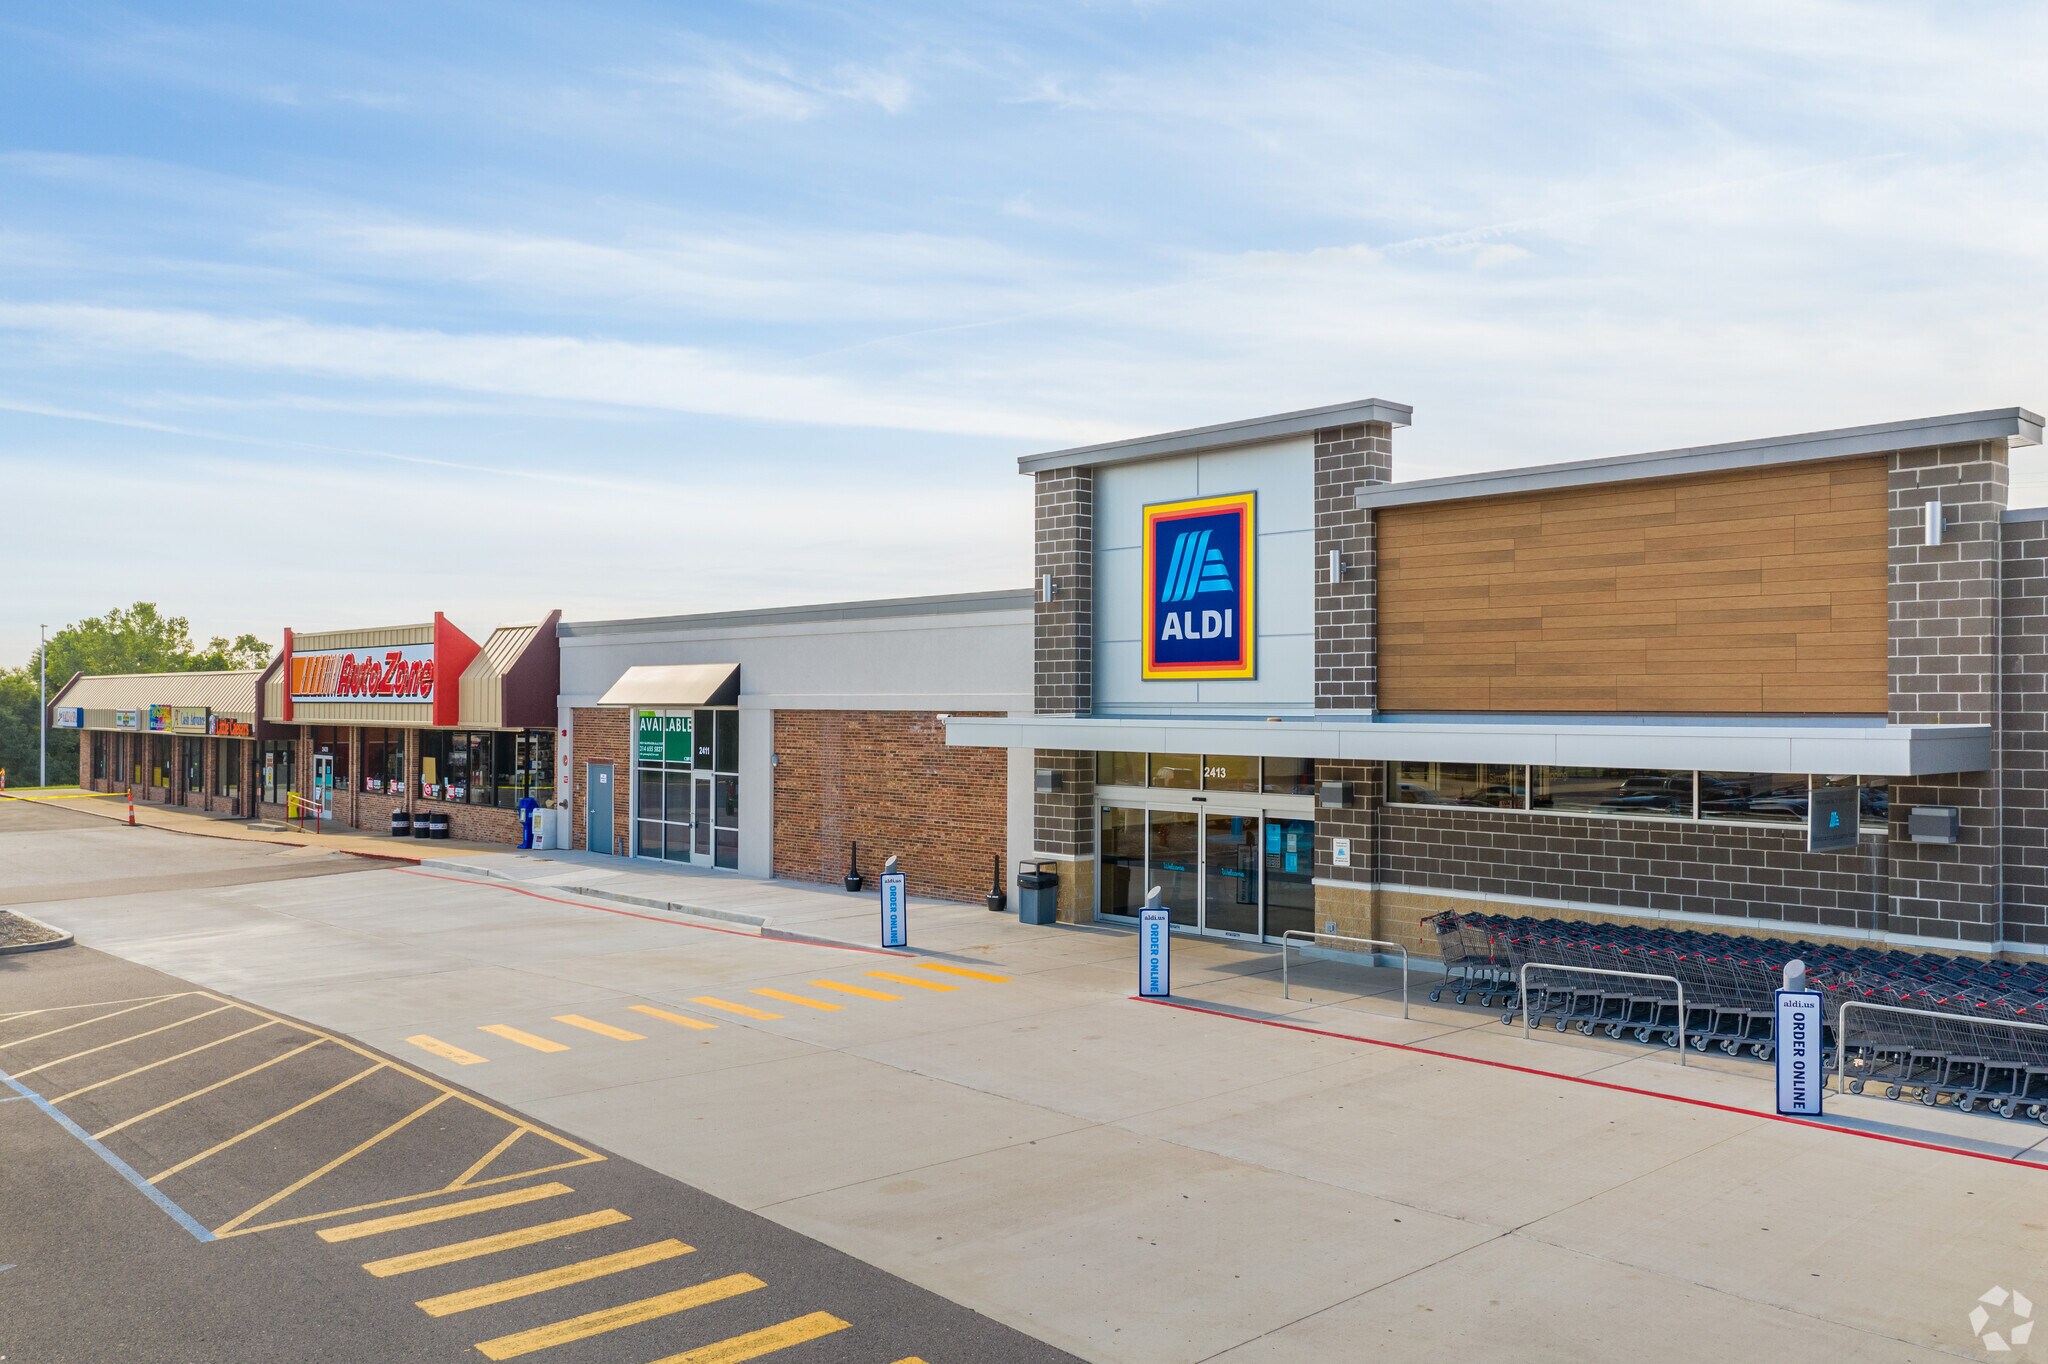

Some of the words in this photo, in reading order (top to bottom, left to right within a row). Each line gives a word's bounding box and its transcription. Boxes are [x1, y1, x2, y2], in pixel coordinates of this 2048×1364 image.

[1161, 609, 1233, 641] ALDI
[336, 651, 435, 698] AutoZone
[181, 711, 190, 725] Cash
[216, 718, 229, 735] Little
[230, 718, 249, 736] Caesars
[640, 718, 692, 732] AVAIABLE
[699, 746, 710, 755] 2411
[1204, 766, 1226, 778] 2413
[1163, 862, 1185, 871] Welcome
[1221, 868, 1245, 877] Welcome
[889, 885, 897, 913] ORDER
[890, 914, 898, 944] ONLINE
[1150, 923, 1159, 956] ORDER
[1150, 957, 1159, 993] ONLINE
[1783, 1000, 1815, 1009] aldi.us
[1793, 1012, 1805, 1057] ORDER
[1793, 1061, 1806, 1109] ONLINE
